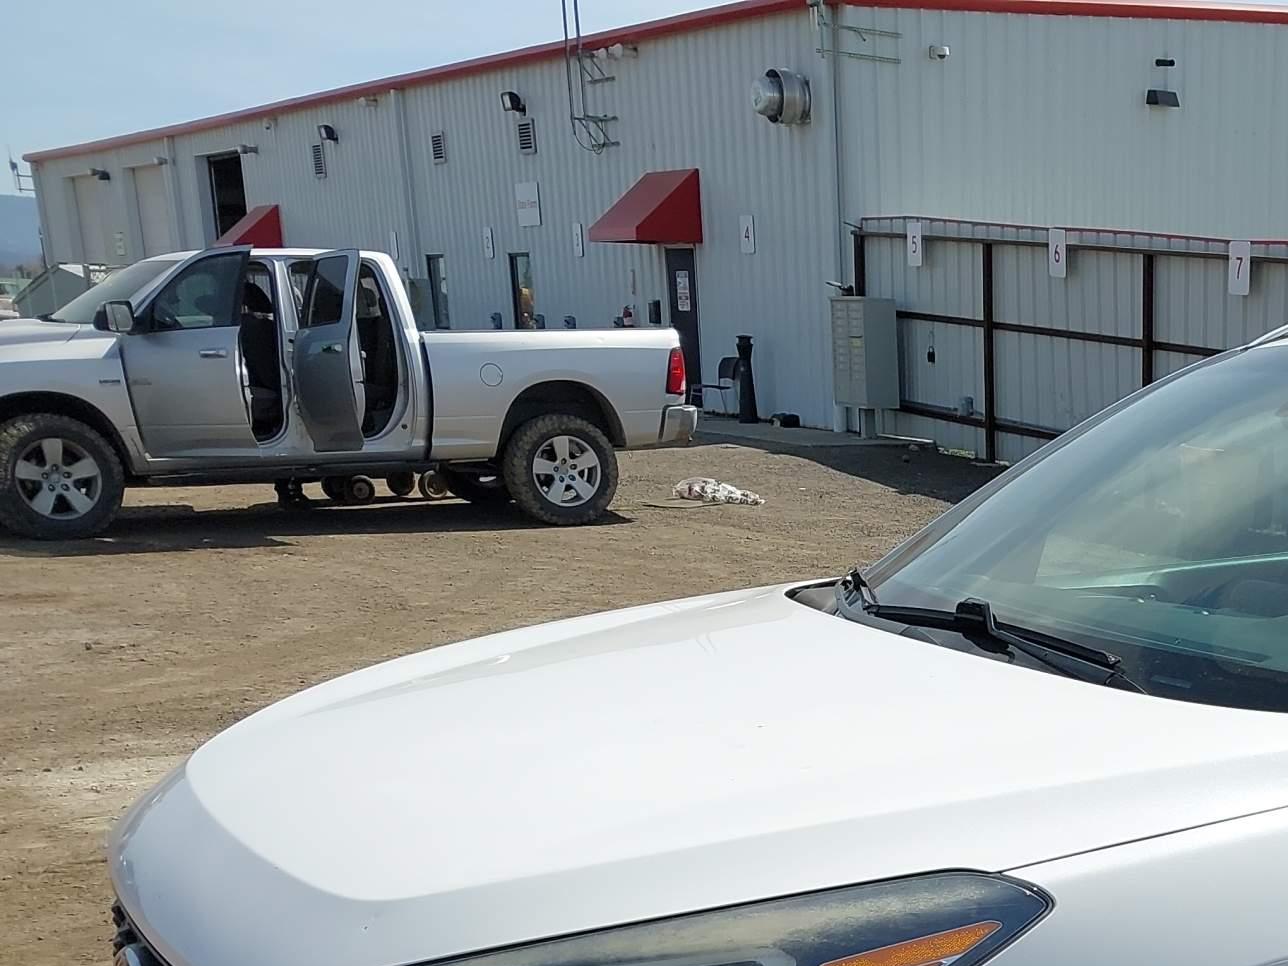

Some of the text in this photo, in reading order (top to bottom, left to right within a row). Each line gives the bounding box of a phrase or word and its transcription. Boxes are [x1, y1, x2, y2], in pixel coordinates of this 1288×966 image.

[744, 226, 750, 241] 4
[911, 235, 918, 254] 5
[1053, 244, 1061, 264] 6
[1235, 256, 1244, 281] 7
